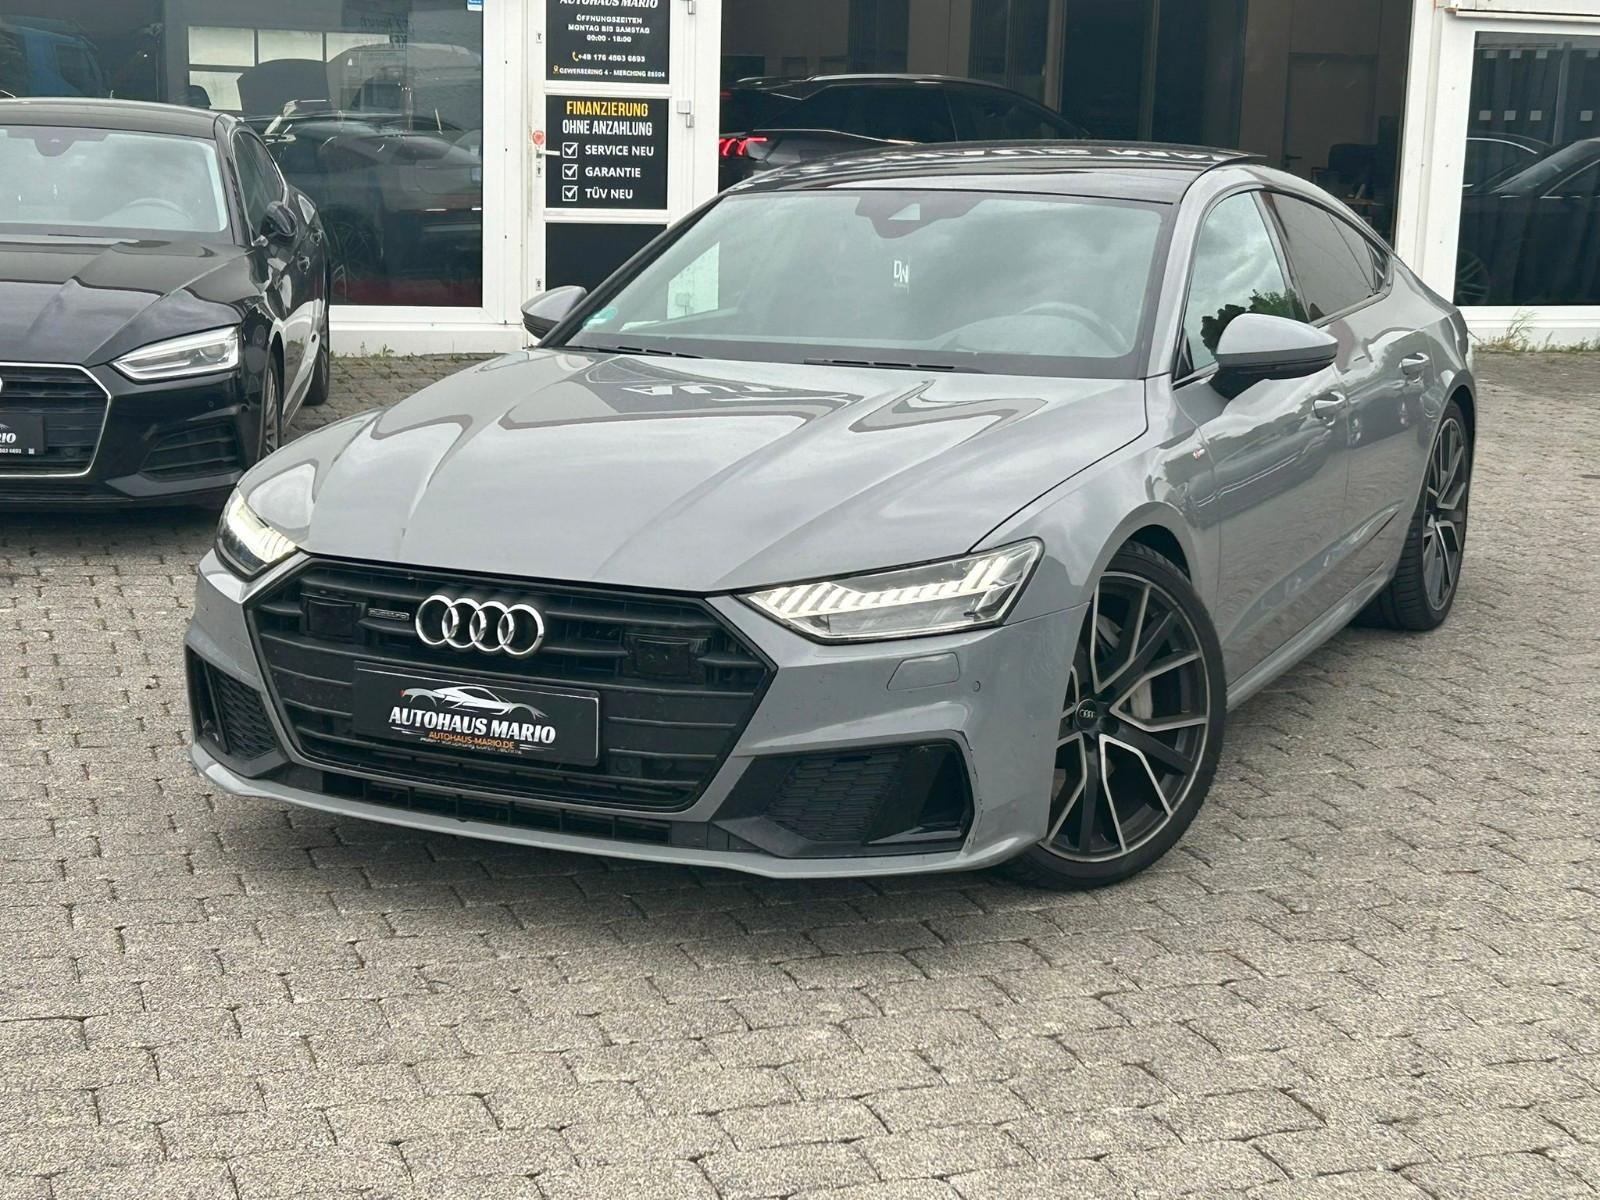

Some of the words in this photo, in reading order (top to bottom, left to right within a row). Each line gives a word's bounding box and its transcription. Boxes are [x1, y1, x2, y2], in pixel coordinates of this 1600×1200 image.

[621, 0, 659, 8] MARIO
[576, 14, 642, 24] ÖFFNUNGSZEITEN
[568, 24, 600, 32] MONTAG
[566, 101, 649, 117] FINANZIERUNG
[562, 119, 590, 134] OHNE
[592, 121, 653, 136] ANZAHLUNG
[585, 145, 628, 156] SERVICE
[631, 146, 655, 157] NEU
[585, 166, 641, 178] GARANTIE
[585, 186, 608, 199] TÜV
[610, 189, 633, 199] NEU
[388, 706, 487, 736] AUTOHAUS
[489, 719, 556, 744] MARIO
[428, 730, 515, 750] AUTOHAUS-MARIO.DE
